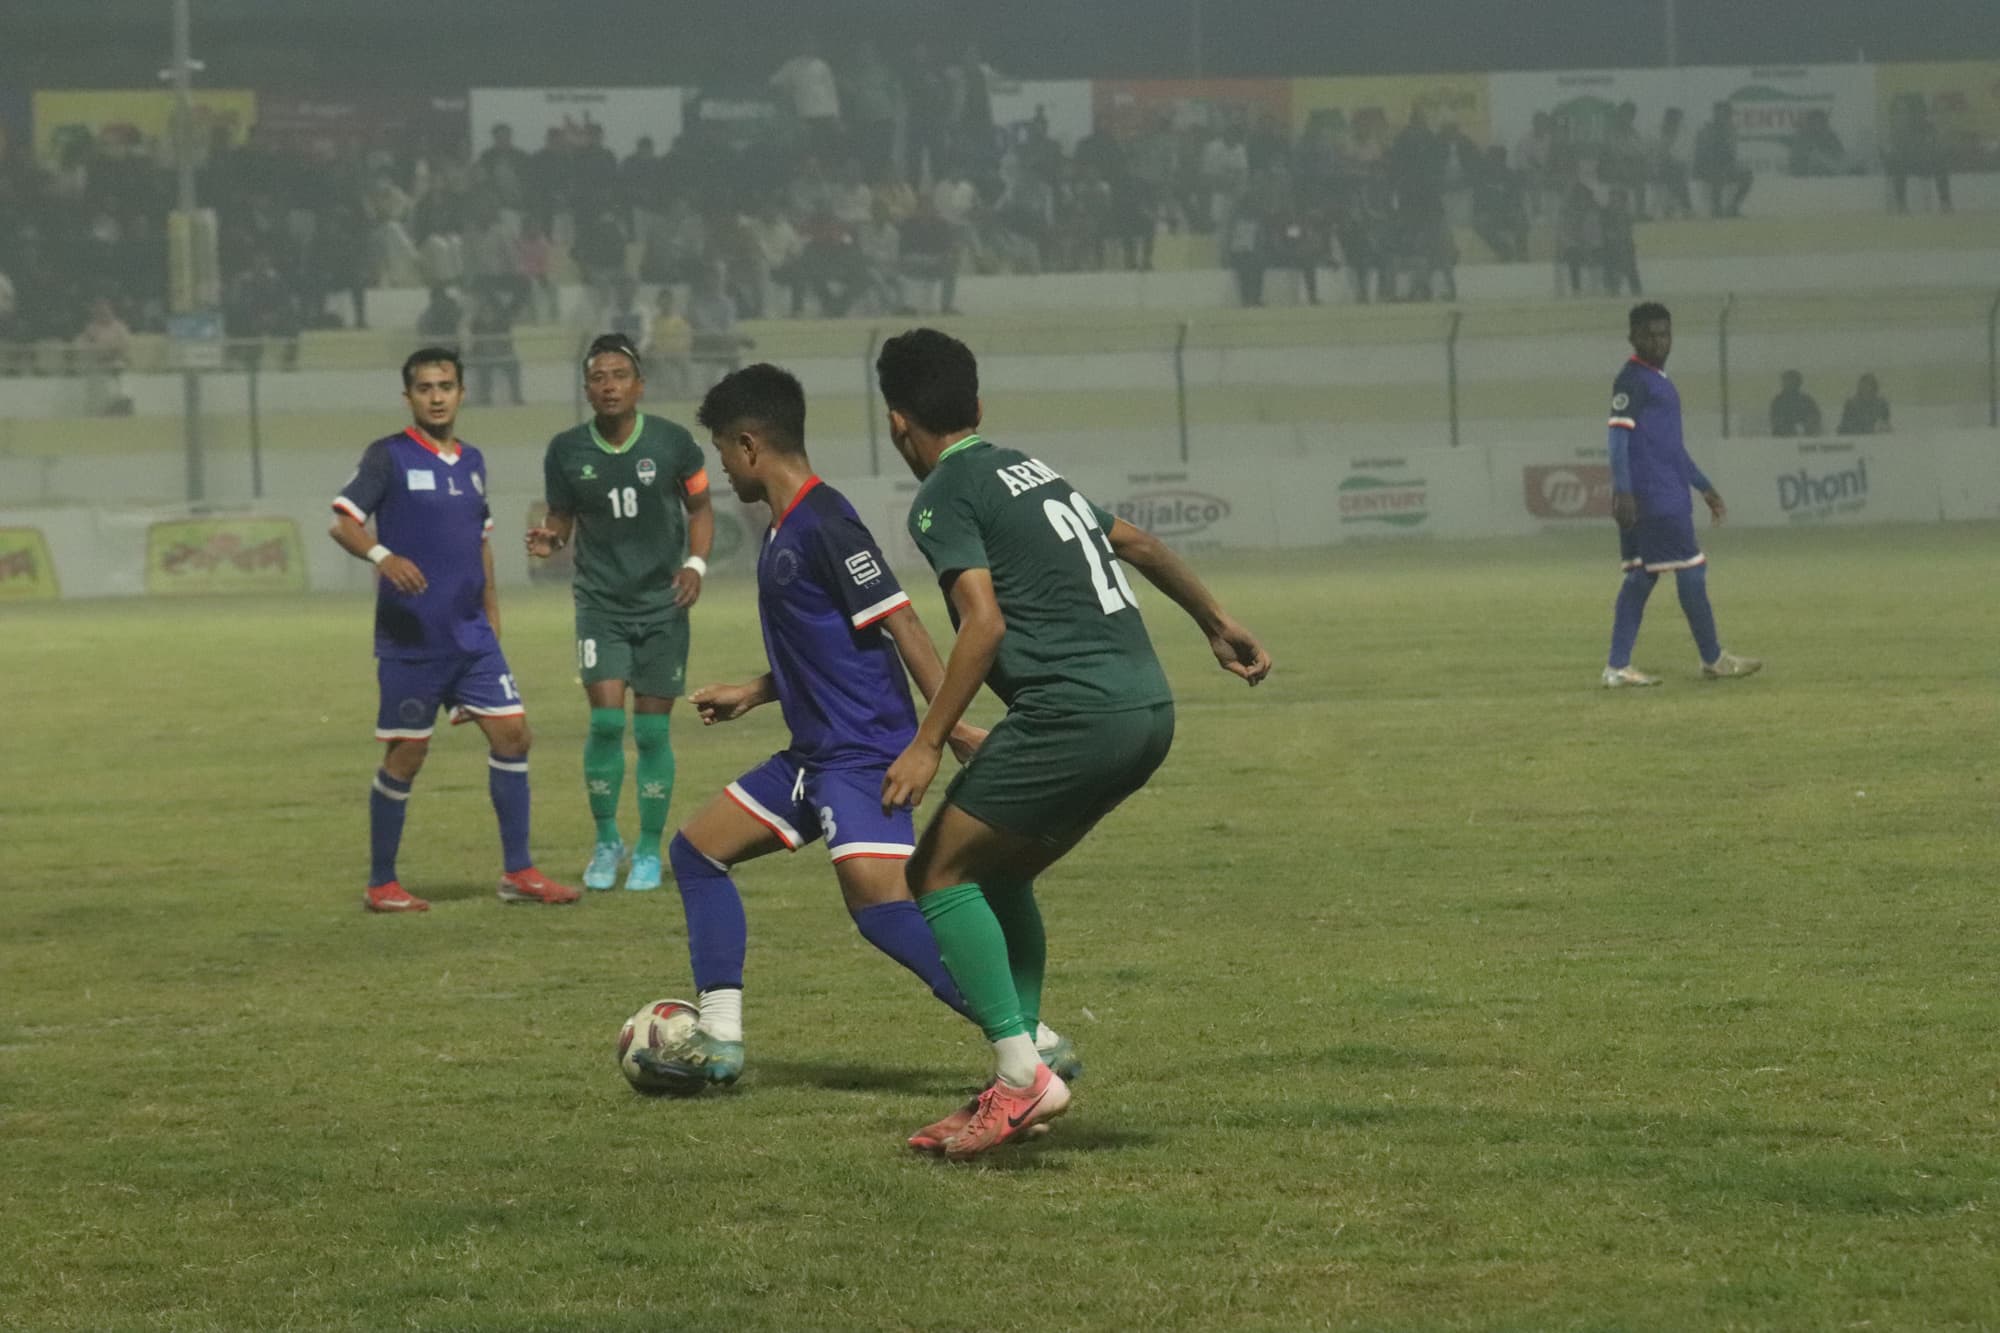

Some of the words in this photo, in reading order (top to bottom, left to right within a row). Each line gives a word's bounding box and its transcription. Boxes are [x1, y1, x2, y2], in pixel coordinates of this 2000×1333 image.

[608, 486, 638, 519] 18
[1116, 499, 1221, 532] Rijalco
[1338, 491, 1427, 514] CENTURY
